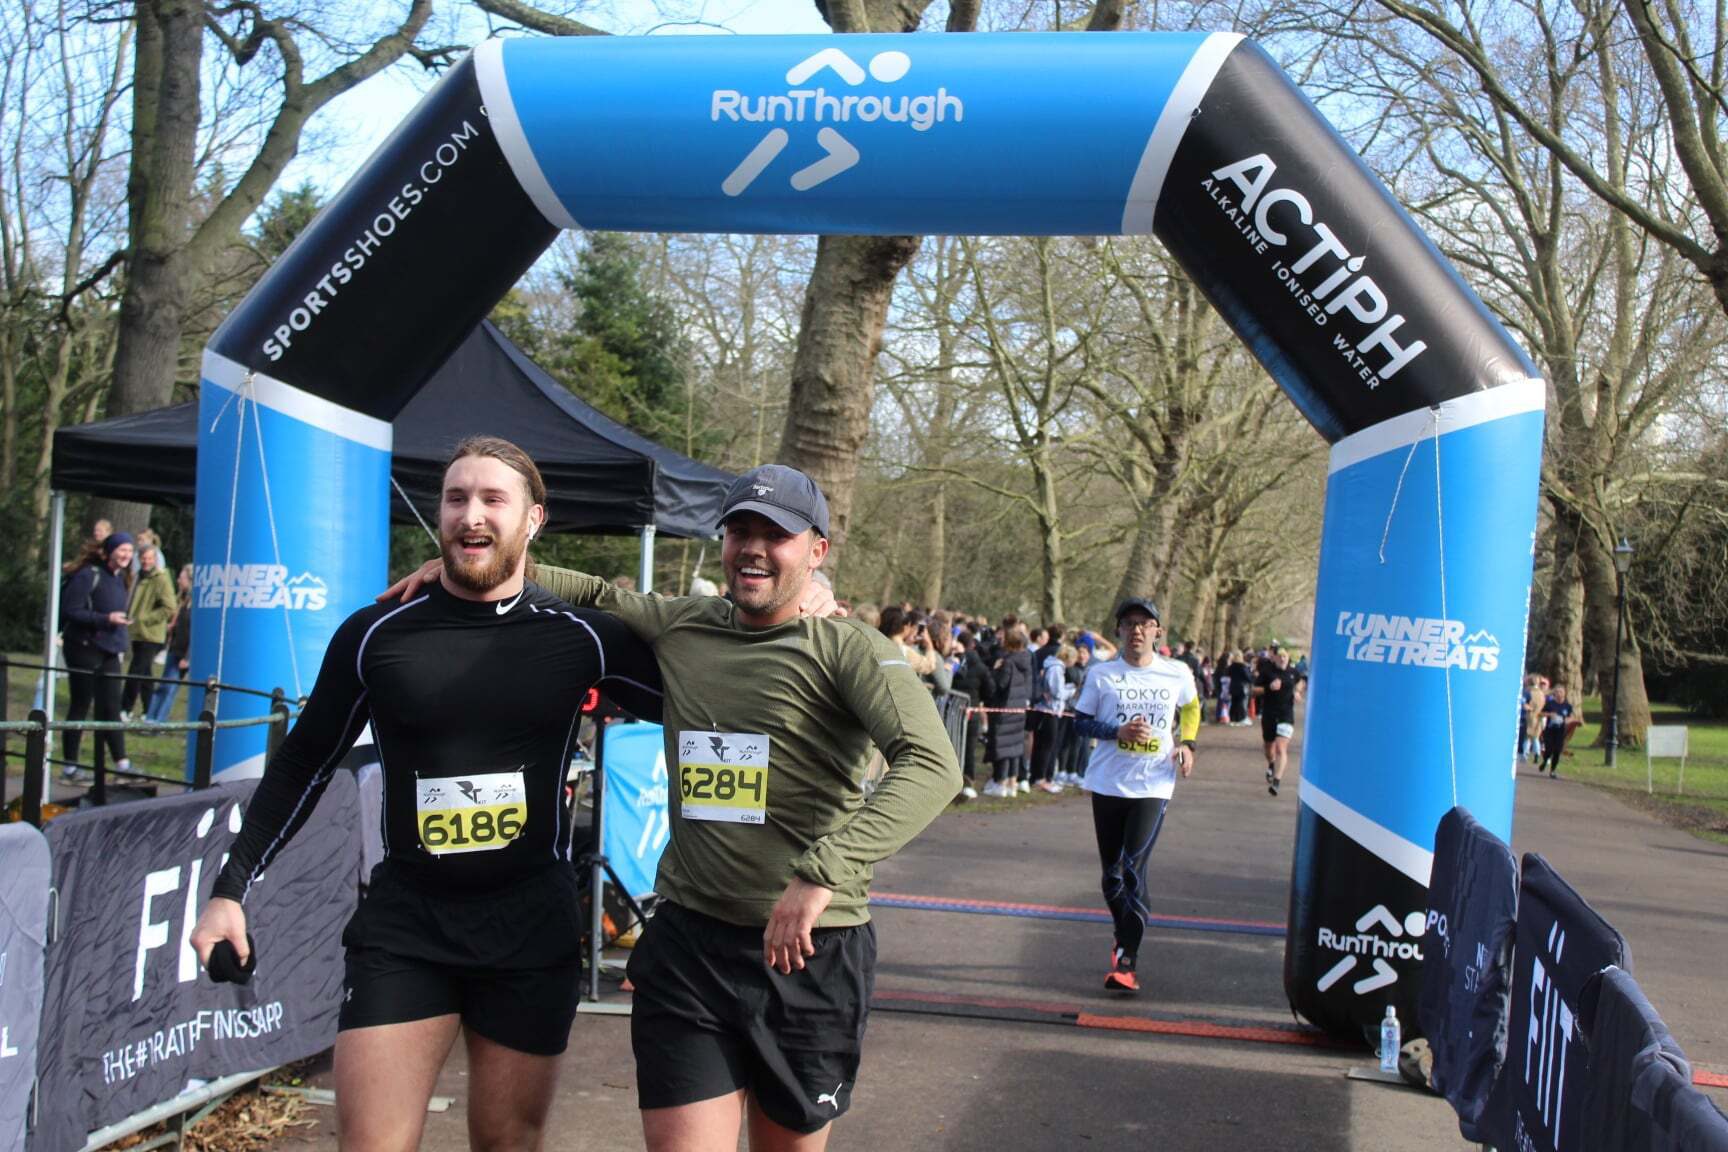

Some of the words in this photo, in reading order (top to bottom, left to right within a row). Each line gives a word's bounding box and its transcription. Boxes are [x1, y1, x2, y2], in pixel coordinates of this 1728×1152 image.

[711, 87, 964, 131] RunThrough
[262, 120, 479, 361] SPORTSSHOES.COM
[1201, 178, 1268, 255] ALKALINE
[1272, 260, 1327, 327] IONISED
[1332, 333, 1381, 391] WATER
[1336, 611, 1465, 645] RUNNER
[1346, 637, 1500, 672] RETREATS
[1116, 688, 1170, 701] TOKYO
[1116, 703, 1170, 711] MARATHON
[681, 766, 763, 803] 6284
[422, 807, 522, 846] 6186
[1317, 926, 1424, 961] RunThrou
